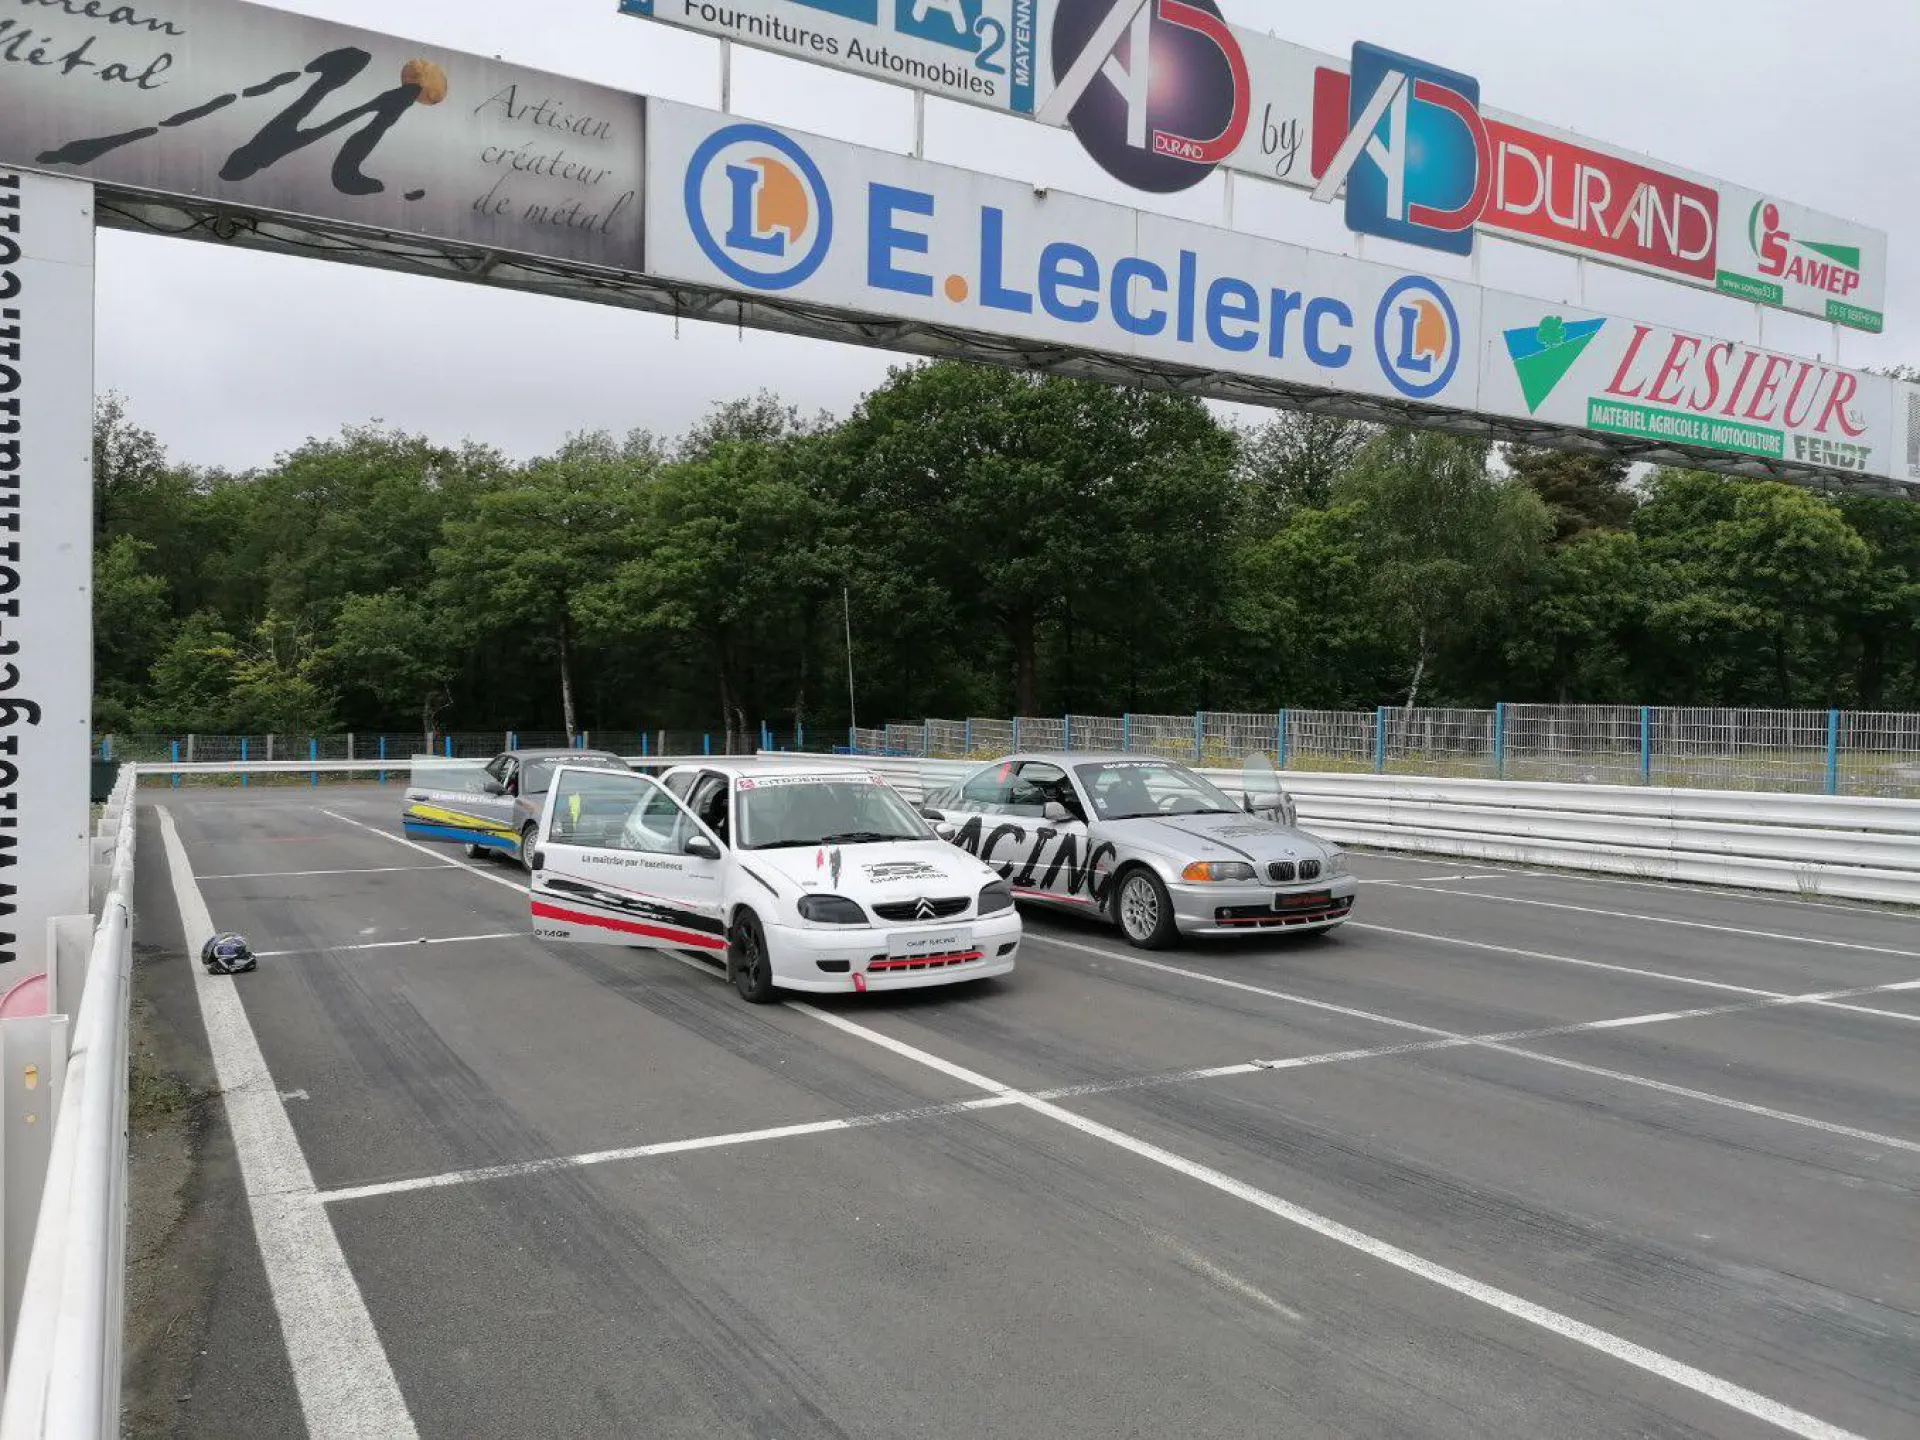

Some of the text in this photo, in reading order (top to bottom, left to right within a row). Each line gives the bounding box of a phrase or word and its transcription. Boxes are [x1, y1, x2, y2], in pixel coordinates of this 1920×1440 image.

[685, 0, 996, 97] Fournitures Automobiles
[474, 84, 612, 140] Artisan
[1261, 103, 1303, 176] by
[480, 141, 612, 185] créateur
[1154, 133, 1204, 159] DURAND
[472, 168, 635, 235] de métal
[1497, 139, 1714, 262] DURAND
[867, 181, 1353, 369] E.Leclerc
[1757, 230, 1860, 297] SAMEP
[1605, 325, 1868, 437] LESIEUR
[1591, 404, 1782, 454] MATERIEL AGRICOLE & MOTOCULTURE
[1793, 434, 1873, 471] FENDT
[625, 859, 639, 868] par
